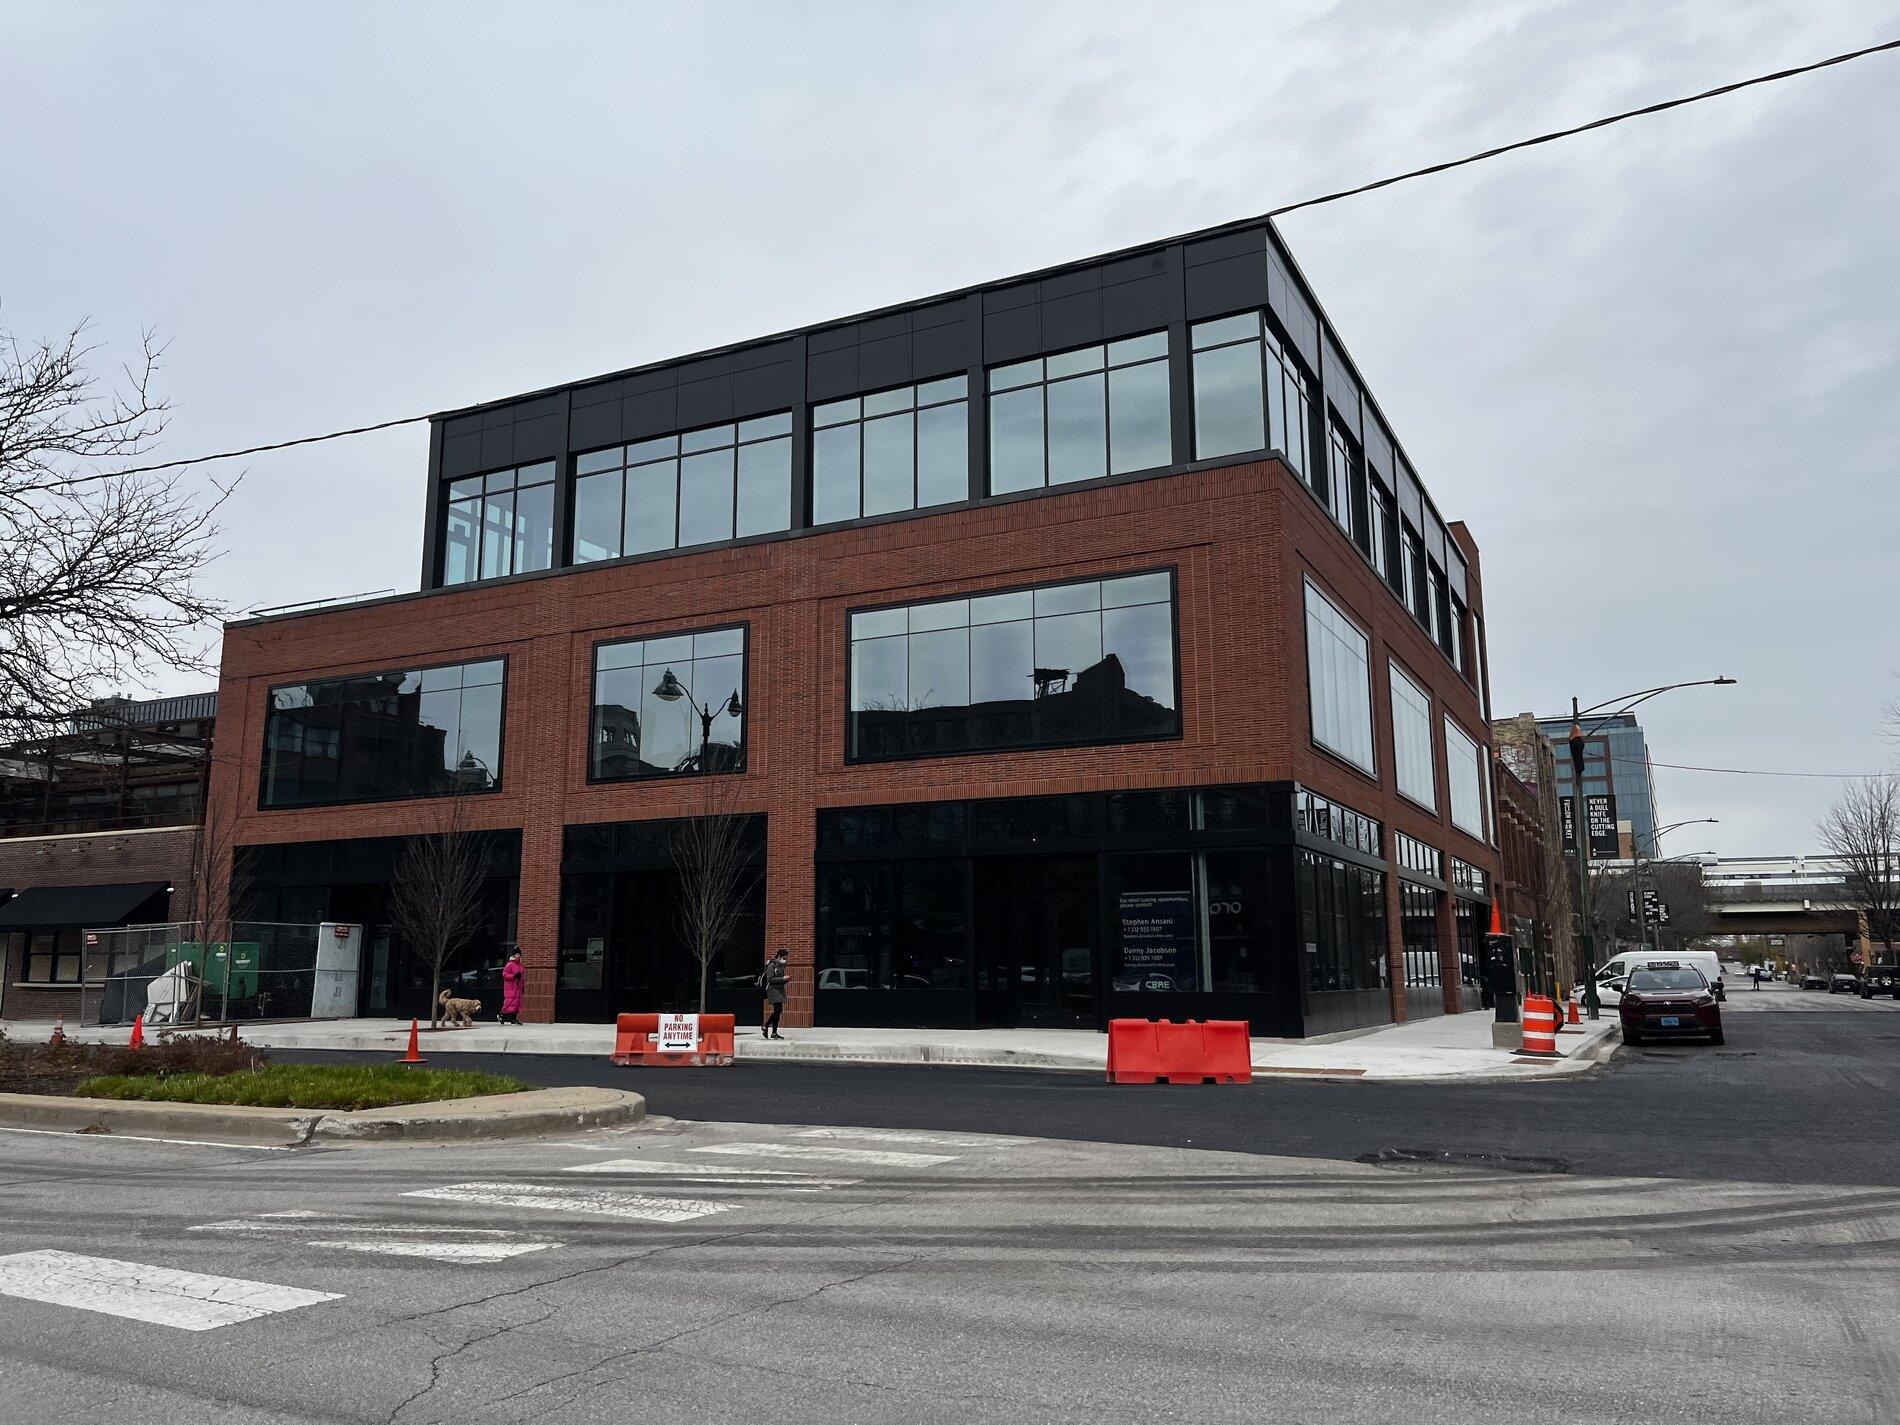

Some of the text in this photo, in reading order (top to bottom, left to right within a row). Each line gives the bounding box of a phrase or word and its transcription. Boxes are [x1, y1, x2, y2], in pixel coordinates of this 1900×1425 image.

[1122, 917, 1173, 926] Stephen Ansani
[1123, 947, 1143, 955] Danny
[1145, 980, 1170, 989] CBRE
[674, 1014, 684, 1022] NO
[664, 1023, 693, 1031] PARKING
[663, 1032, 693, 1040] ANYTIME
